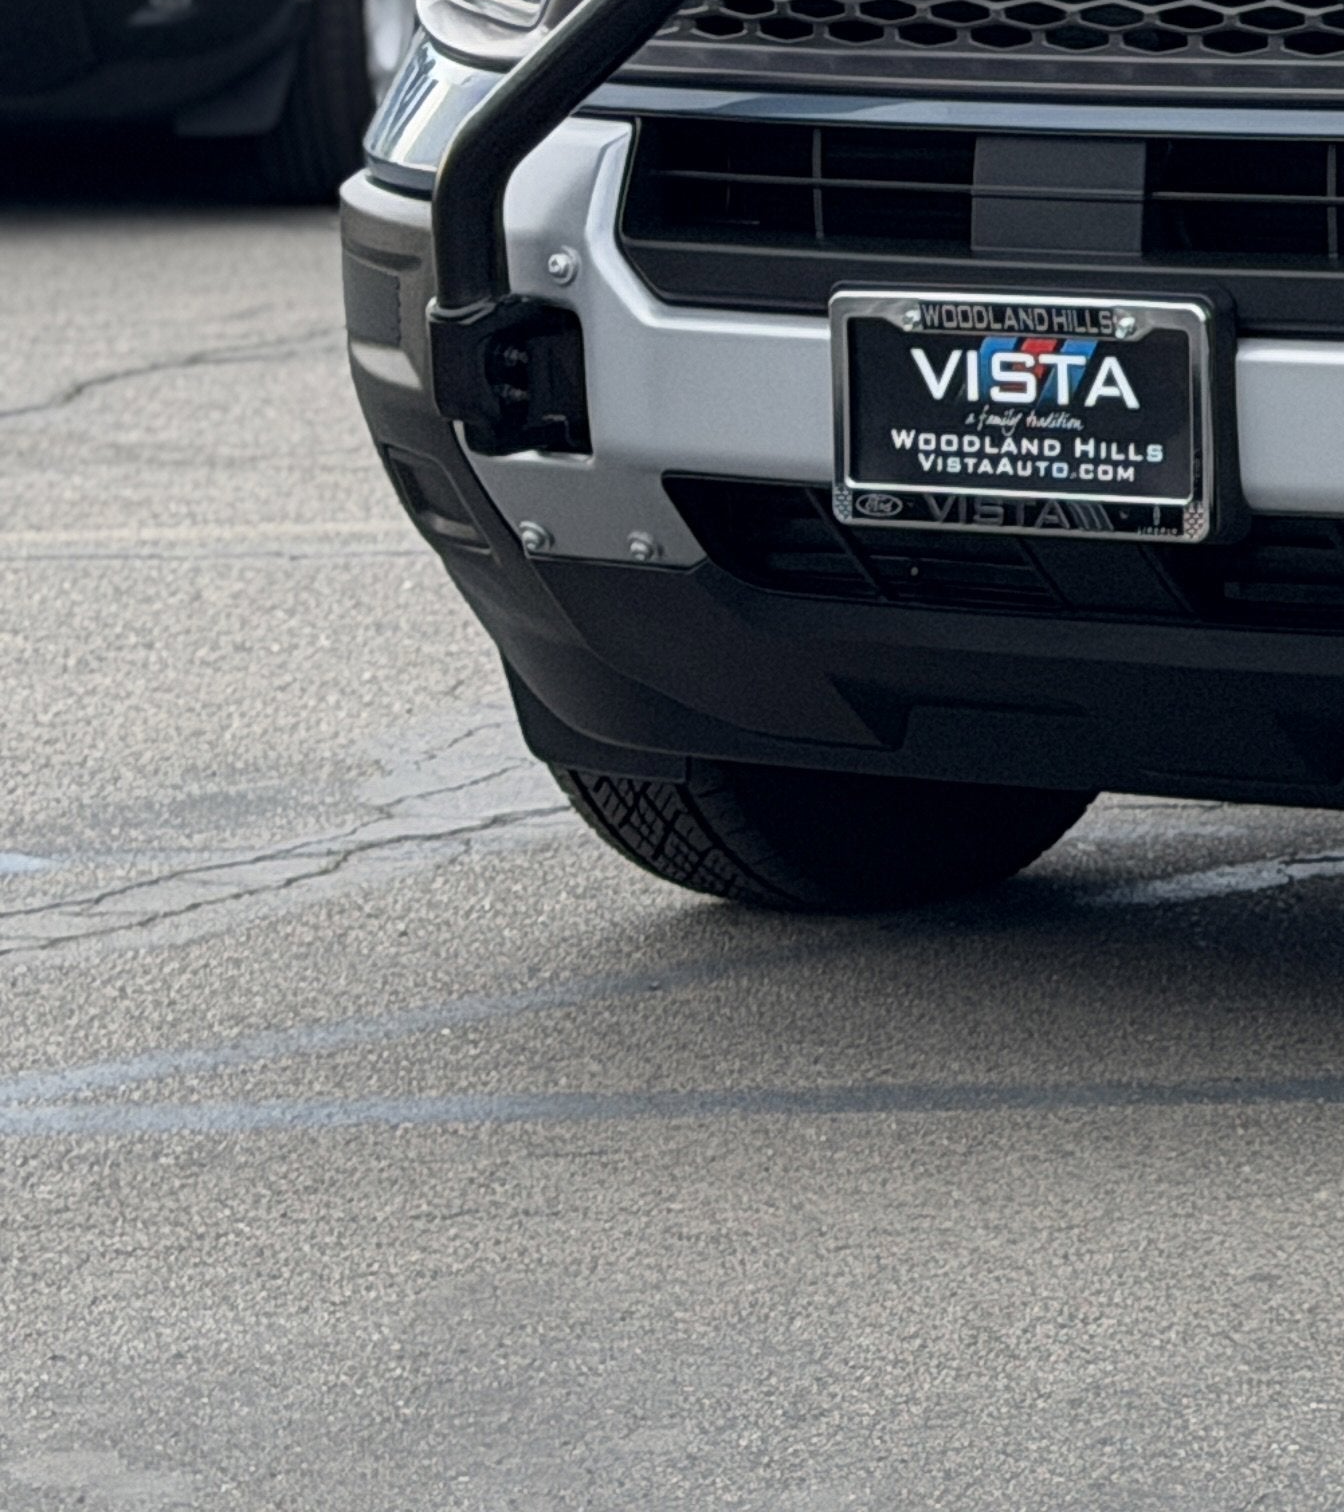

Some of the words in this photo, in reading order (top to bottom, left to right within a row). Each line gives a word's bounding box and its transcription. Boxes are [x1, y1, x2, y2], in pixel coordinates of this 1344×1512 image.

[921, 304, 1049, 333] WOODLAND
[1052, 307, 1114, 335] HILLS
[910, 347, 1141, 410] VISTA
[976, 404, 1024, 437] family
[1025, 408, 1086, 431] tradition
[890, 428, 1061, 458] WOODLAND
[1074, 437, 1164, 463] HILLS
[923, 494, 1071, 530] VISTA
